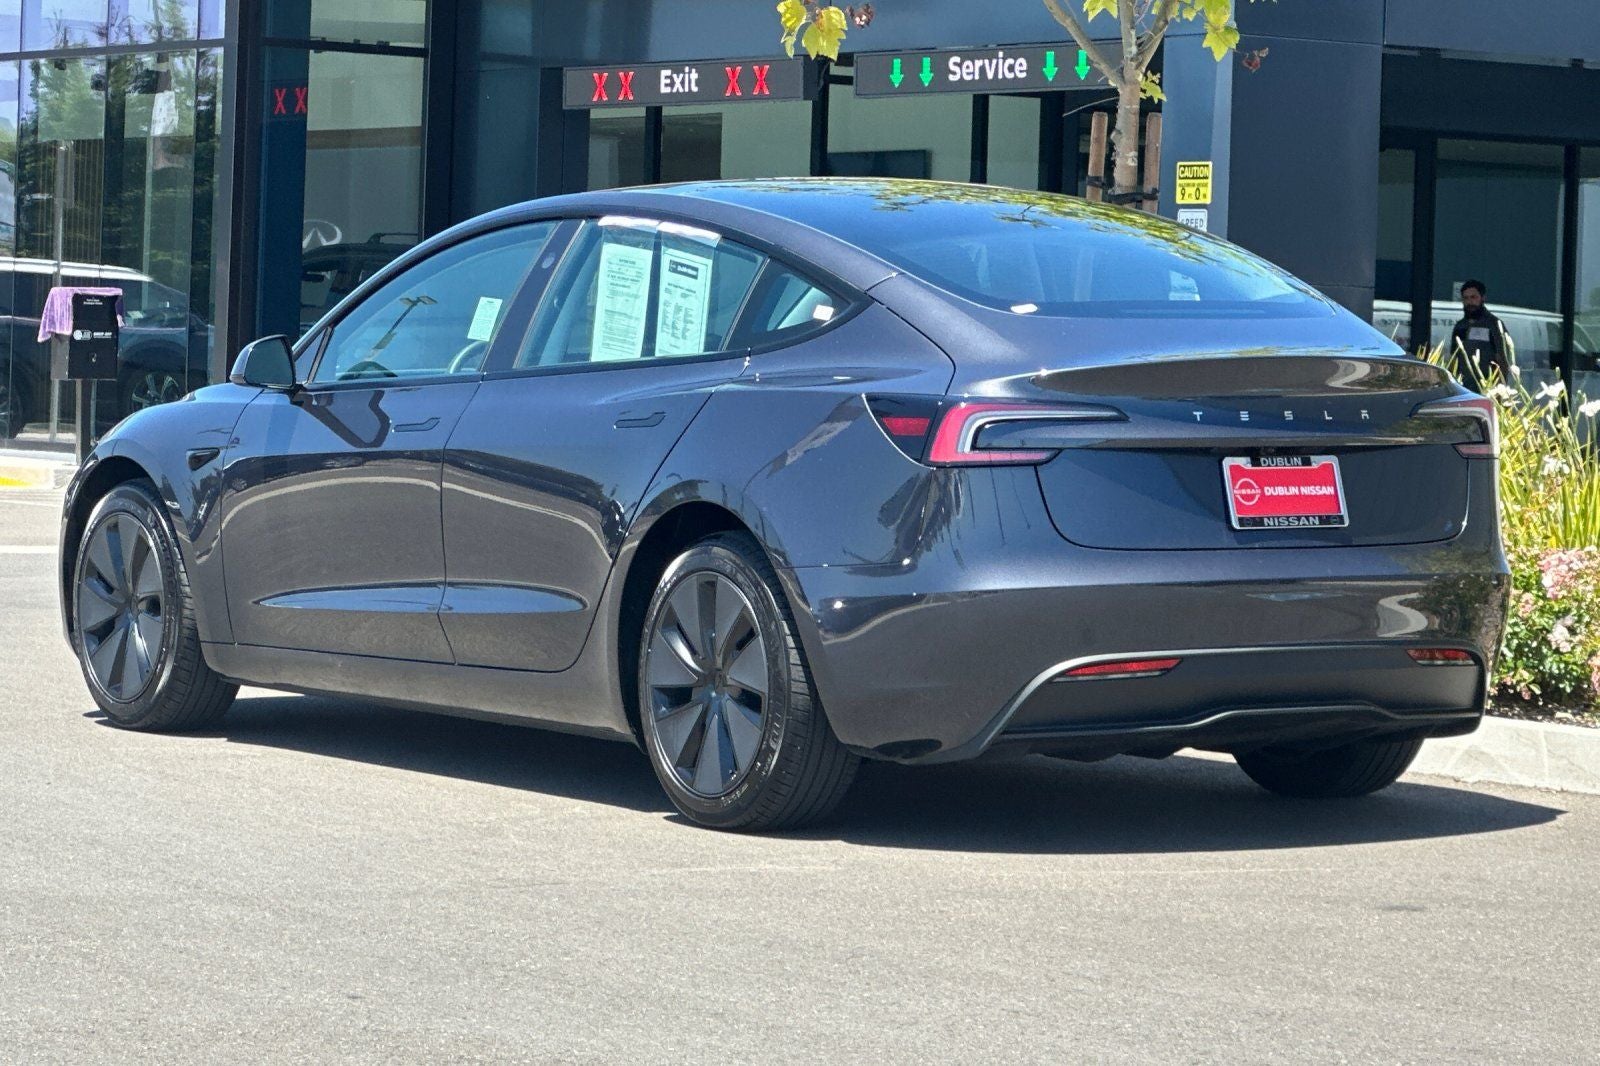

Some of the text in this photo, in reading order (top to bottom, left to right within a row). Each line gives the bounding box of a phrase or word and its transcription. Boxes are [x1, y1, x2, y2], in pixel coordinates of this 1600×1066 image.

[948, 51, 1027, 82] Service
[660, 66, 698, 94] Exit
[1179, 166, 1209, 178] CAUTION
[1180, 187, 1186, 200] 9
[1194, 187, 1201, 200] 0
[1192, 409, 1370, 422] TESLA
[1260, 457, 1302, 466] DUBLIN
[1264, 485, 1335, 496] DUBLIN NISSAN
[1263, 516, 1320, 526] NISSAN
